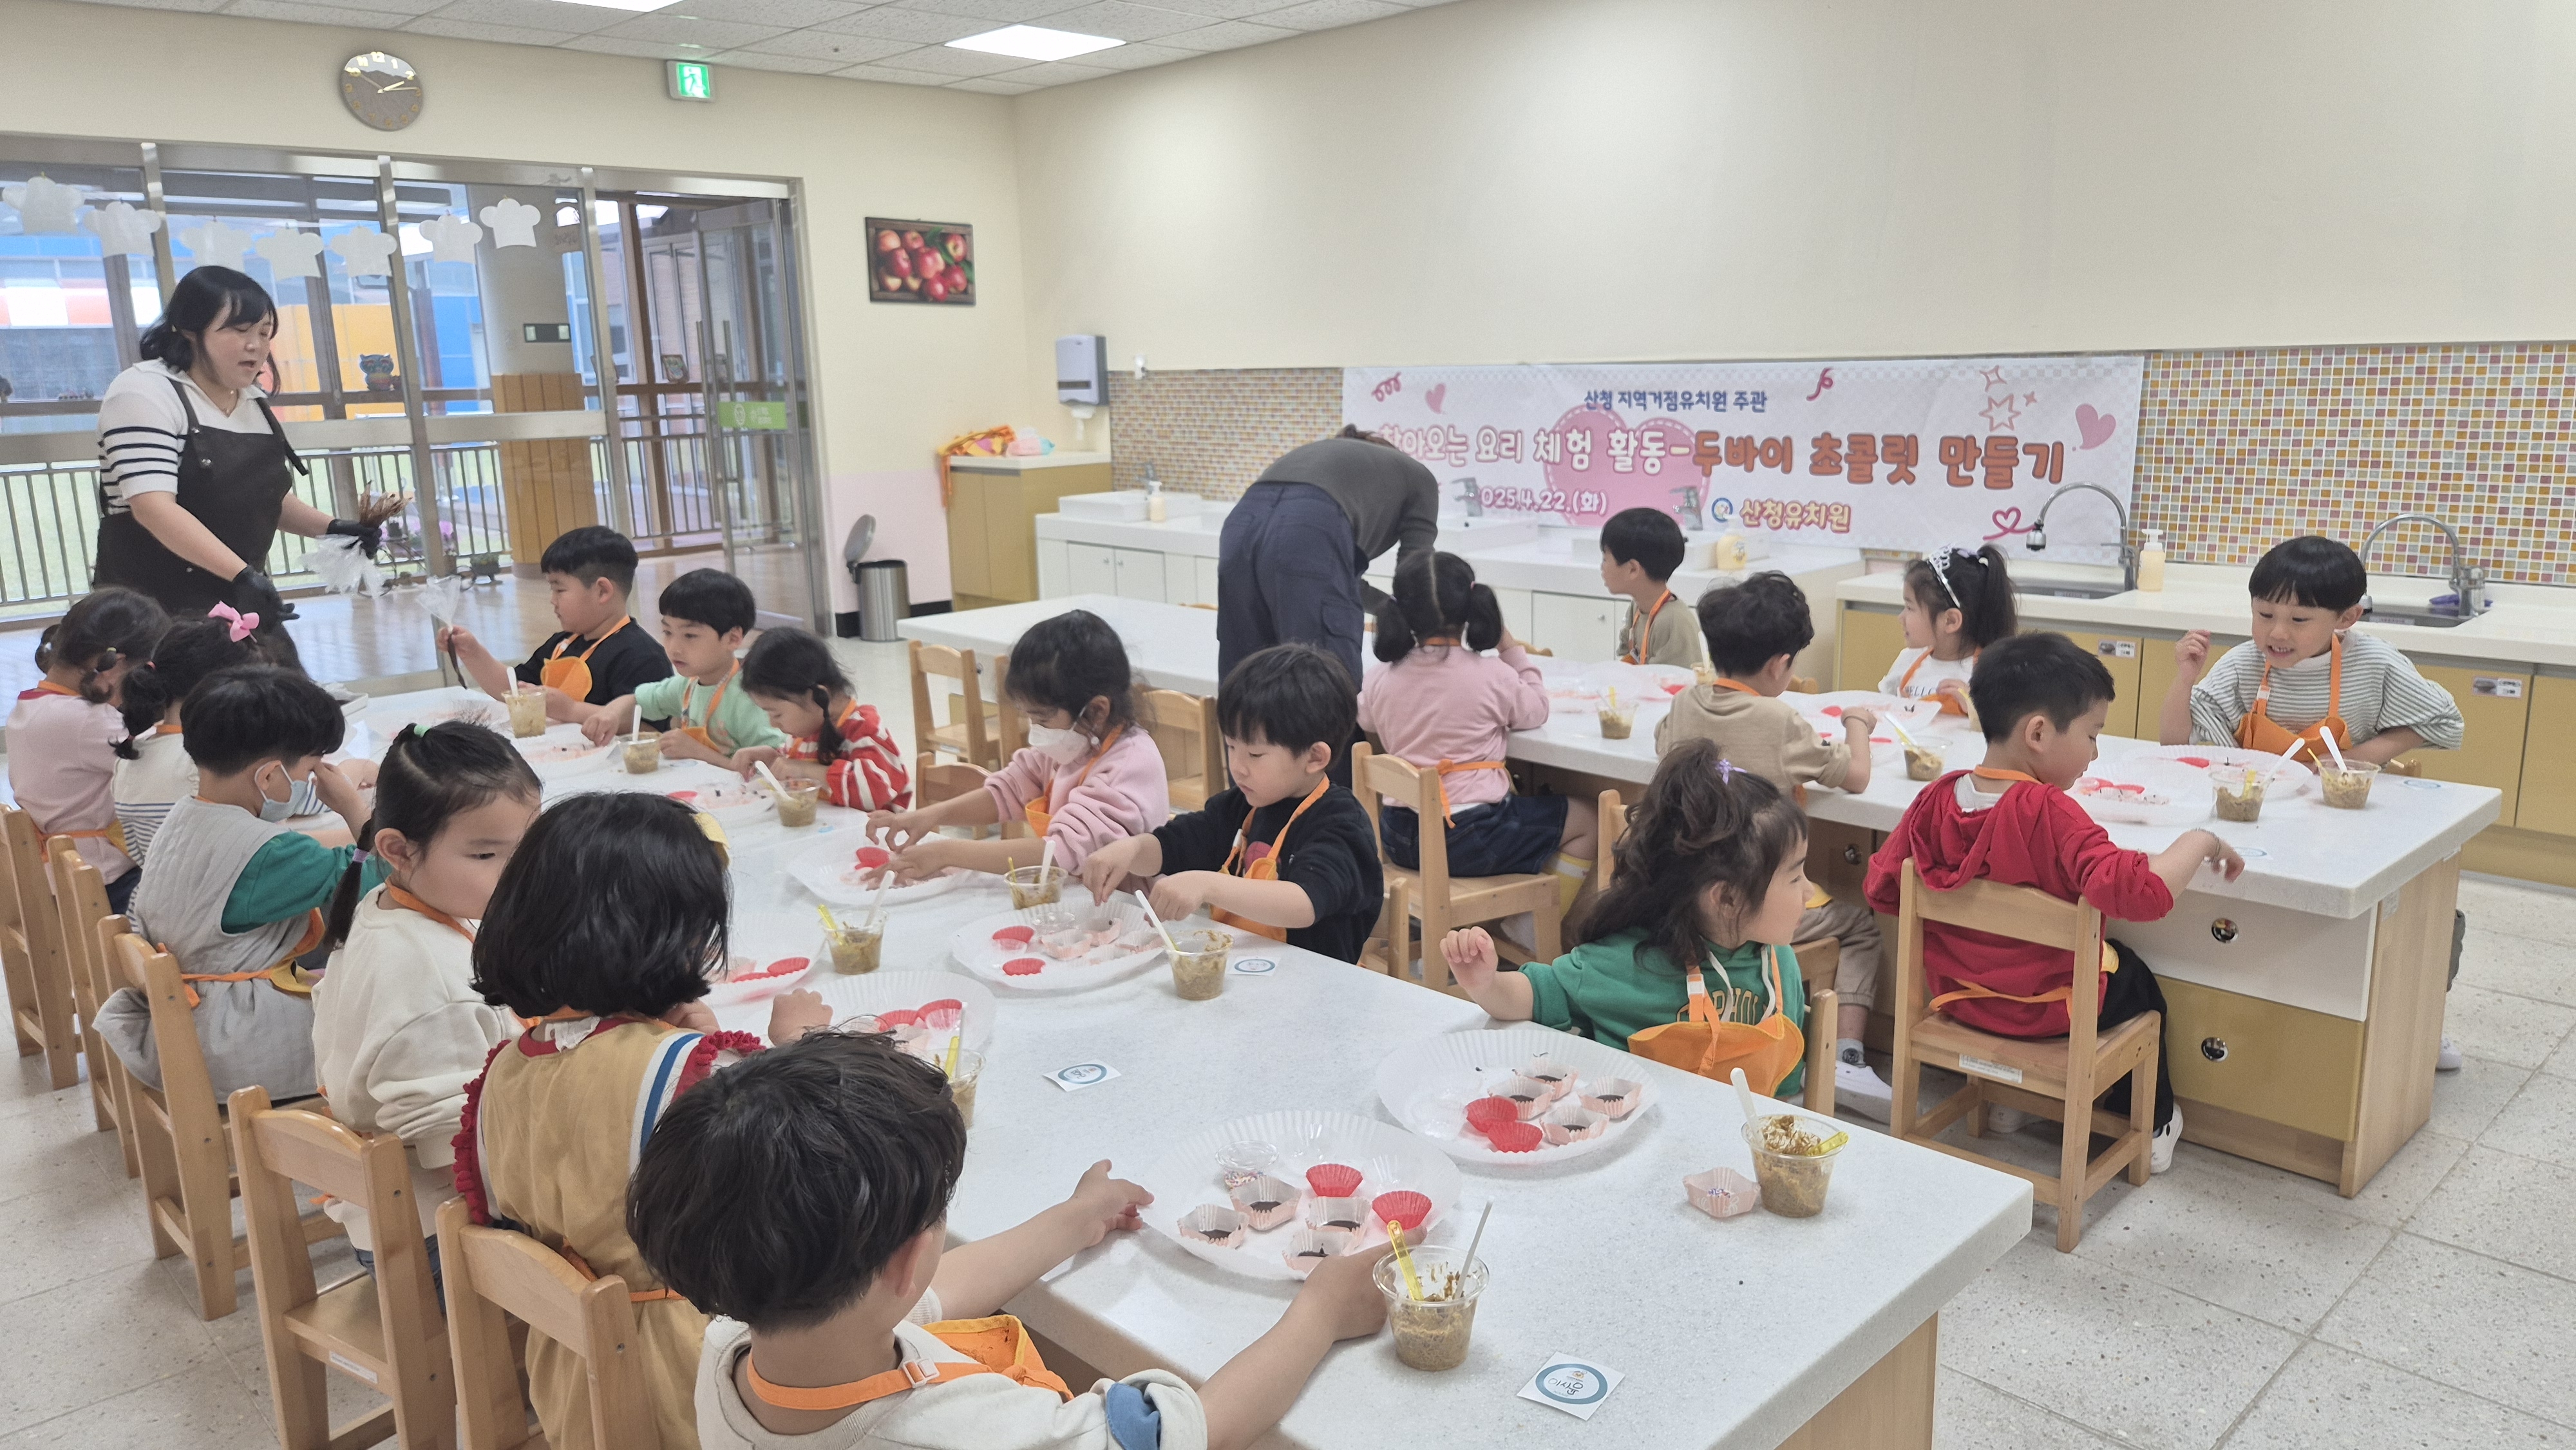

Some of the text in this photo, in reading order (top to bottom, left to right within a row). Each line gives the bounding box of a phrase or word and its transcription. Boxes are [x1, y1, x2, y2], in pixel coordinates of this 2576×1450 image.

[391, 59, 398, 69] 1
[1584, 390, 1768, 413] 산청 지역거점유치원 주관
[1475, 424, 1526, 465] 요리
[1533, 426, 1593, 471] 체험
[1808, 431, 1919, 485] 초콜릿
[1938, 435, 2065, 490] 만들기
[1479, 485, 1607, 516] 025.4.22.(화)
[1739, 498, 1852, 534] 산청유치원
